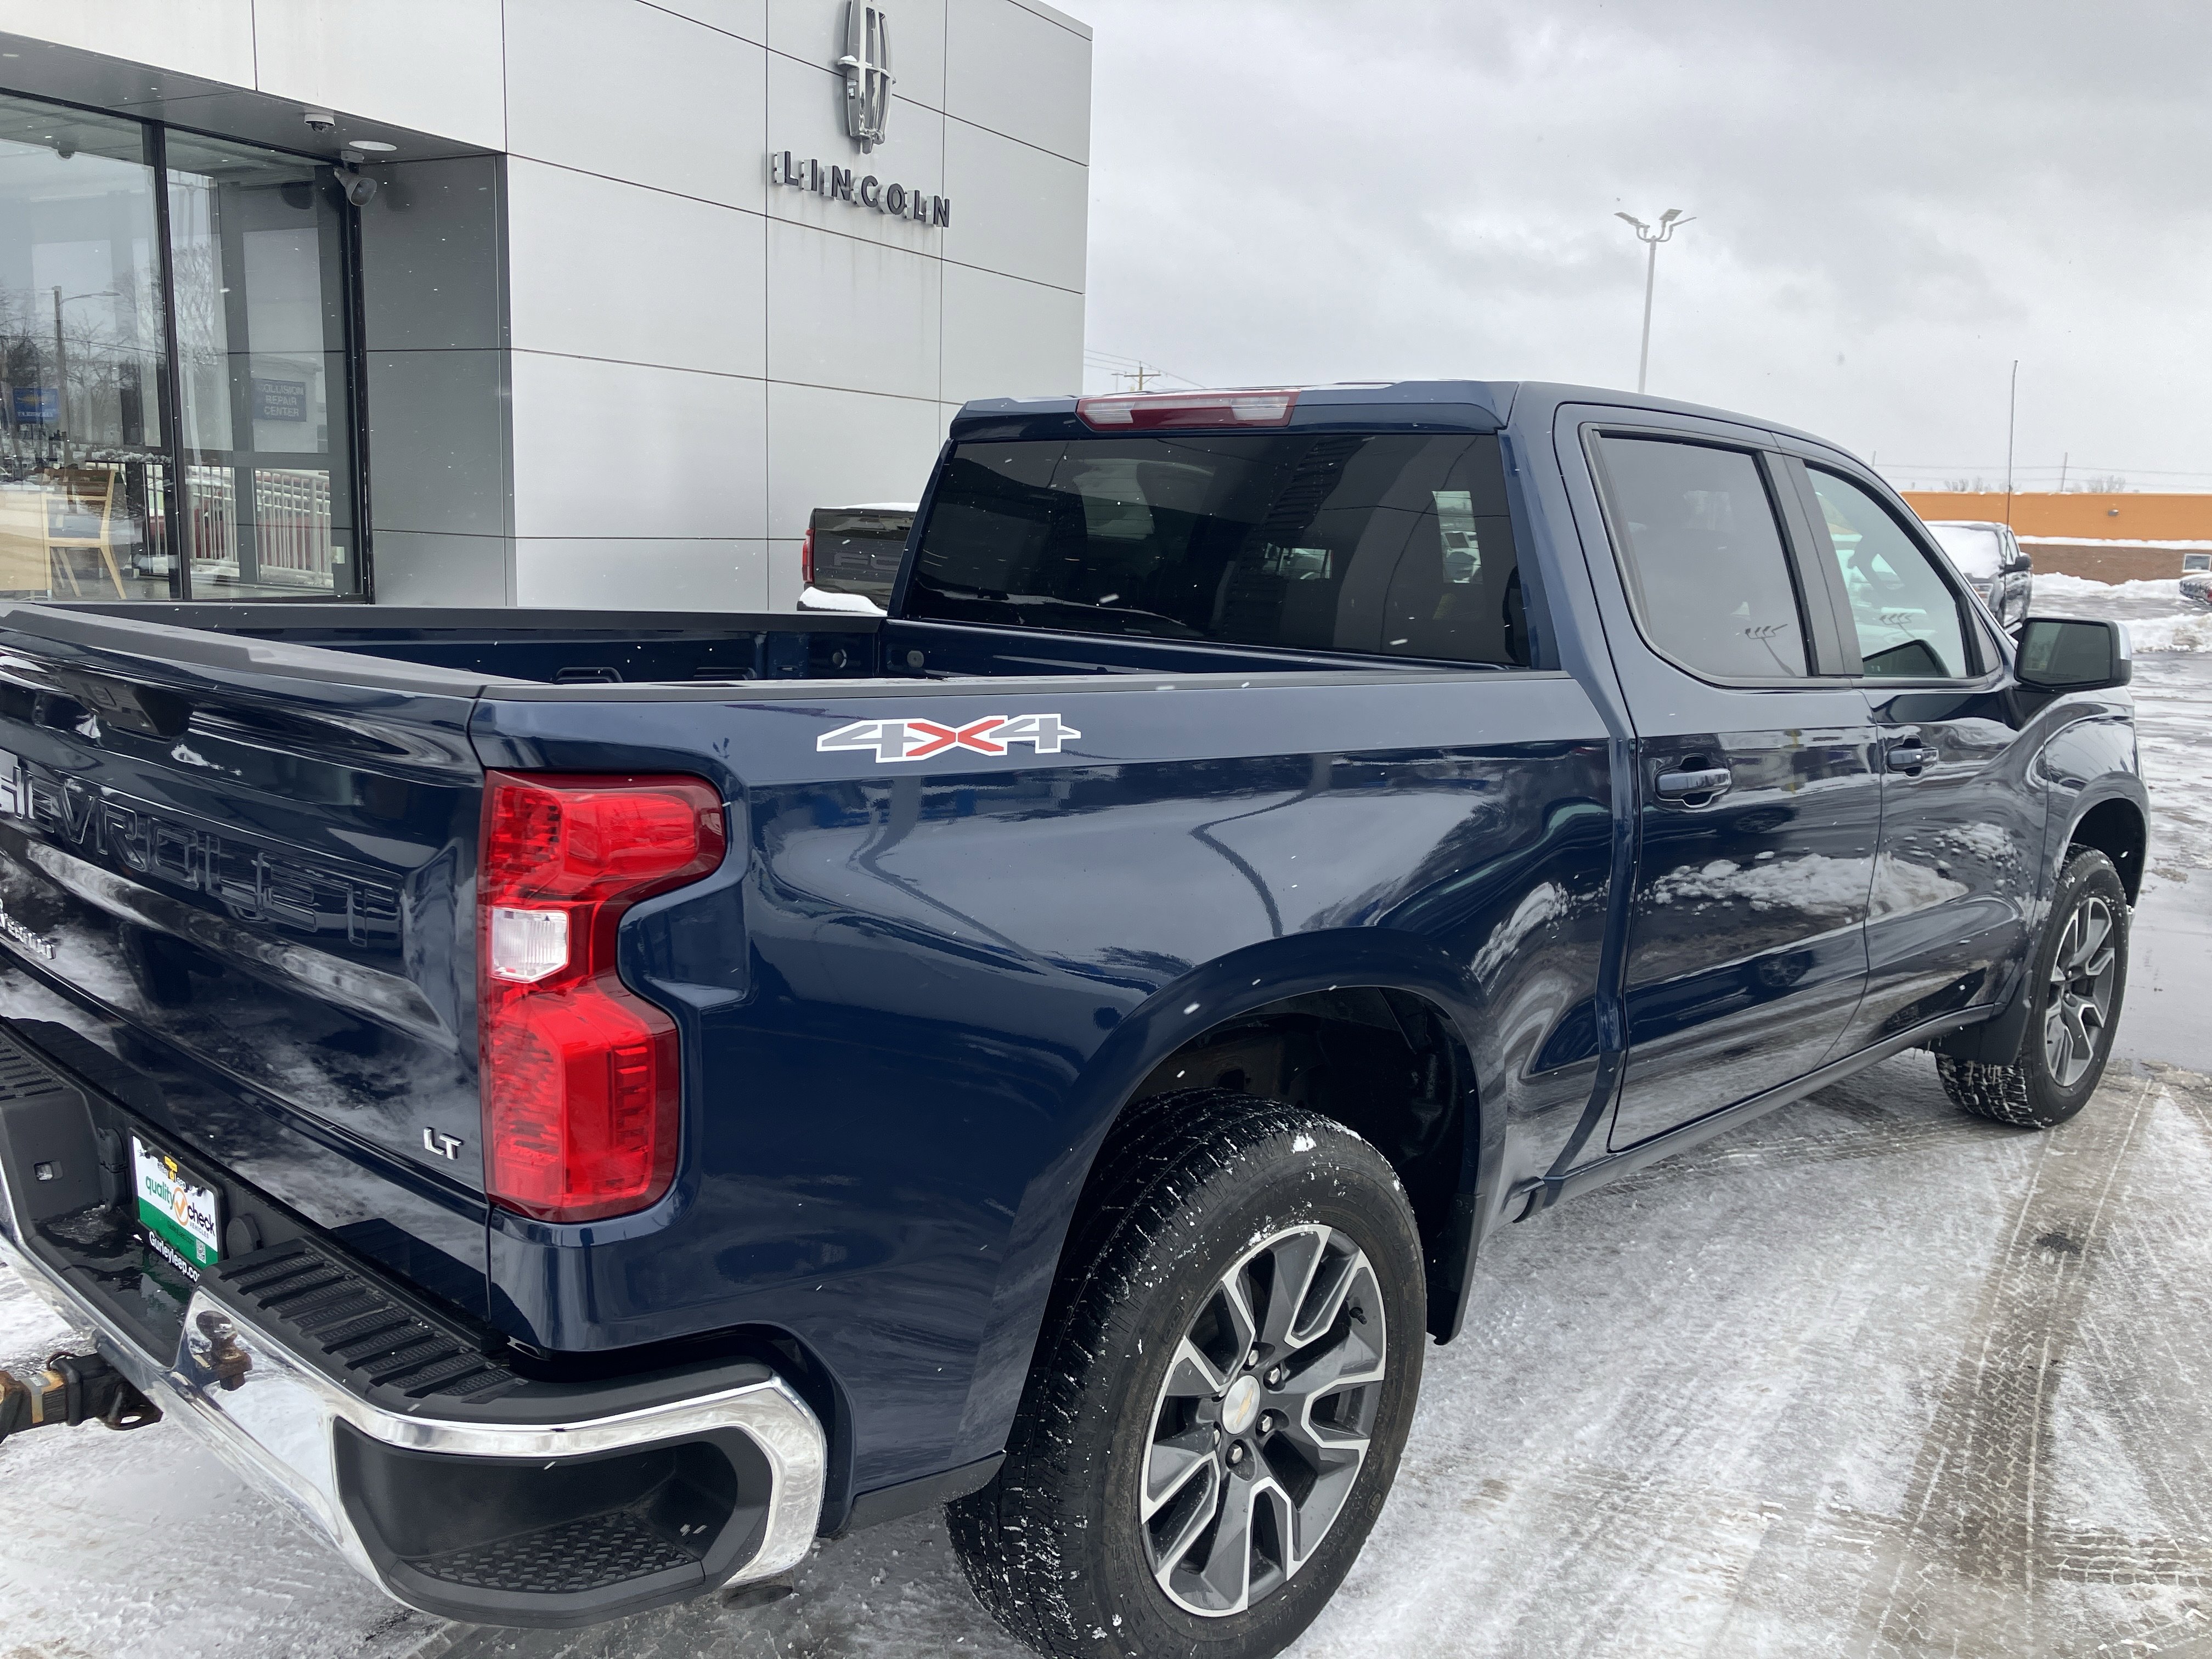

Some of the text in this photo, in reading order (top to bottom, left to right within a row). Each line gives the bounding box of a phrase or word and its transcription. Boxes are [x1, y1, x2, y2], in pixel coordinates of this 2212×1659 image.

[776, 150, 950, 227] LINCOLN
[261, 383, 304, 395] OLLISION
[266, 395, 297, 405] REPAIR
[264, 407, 299, 417] CENTER
[0, 765, 396, 948] HEVROLET
[424, 1126, 463, 1160] LT
[145, 1176, 174, 1210] quality
[187, 1201, 216, 1237] check
